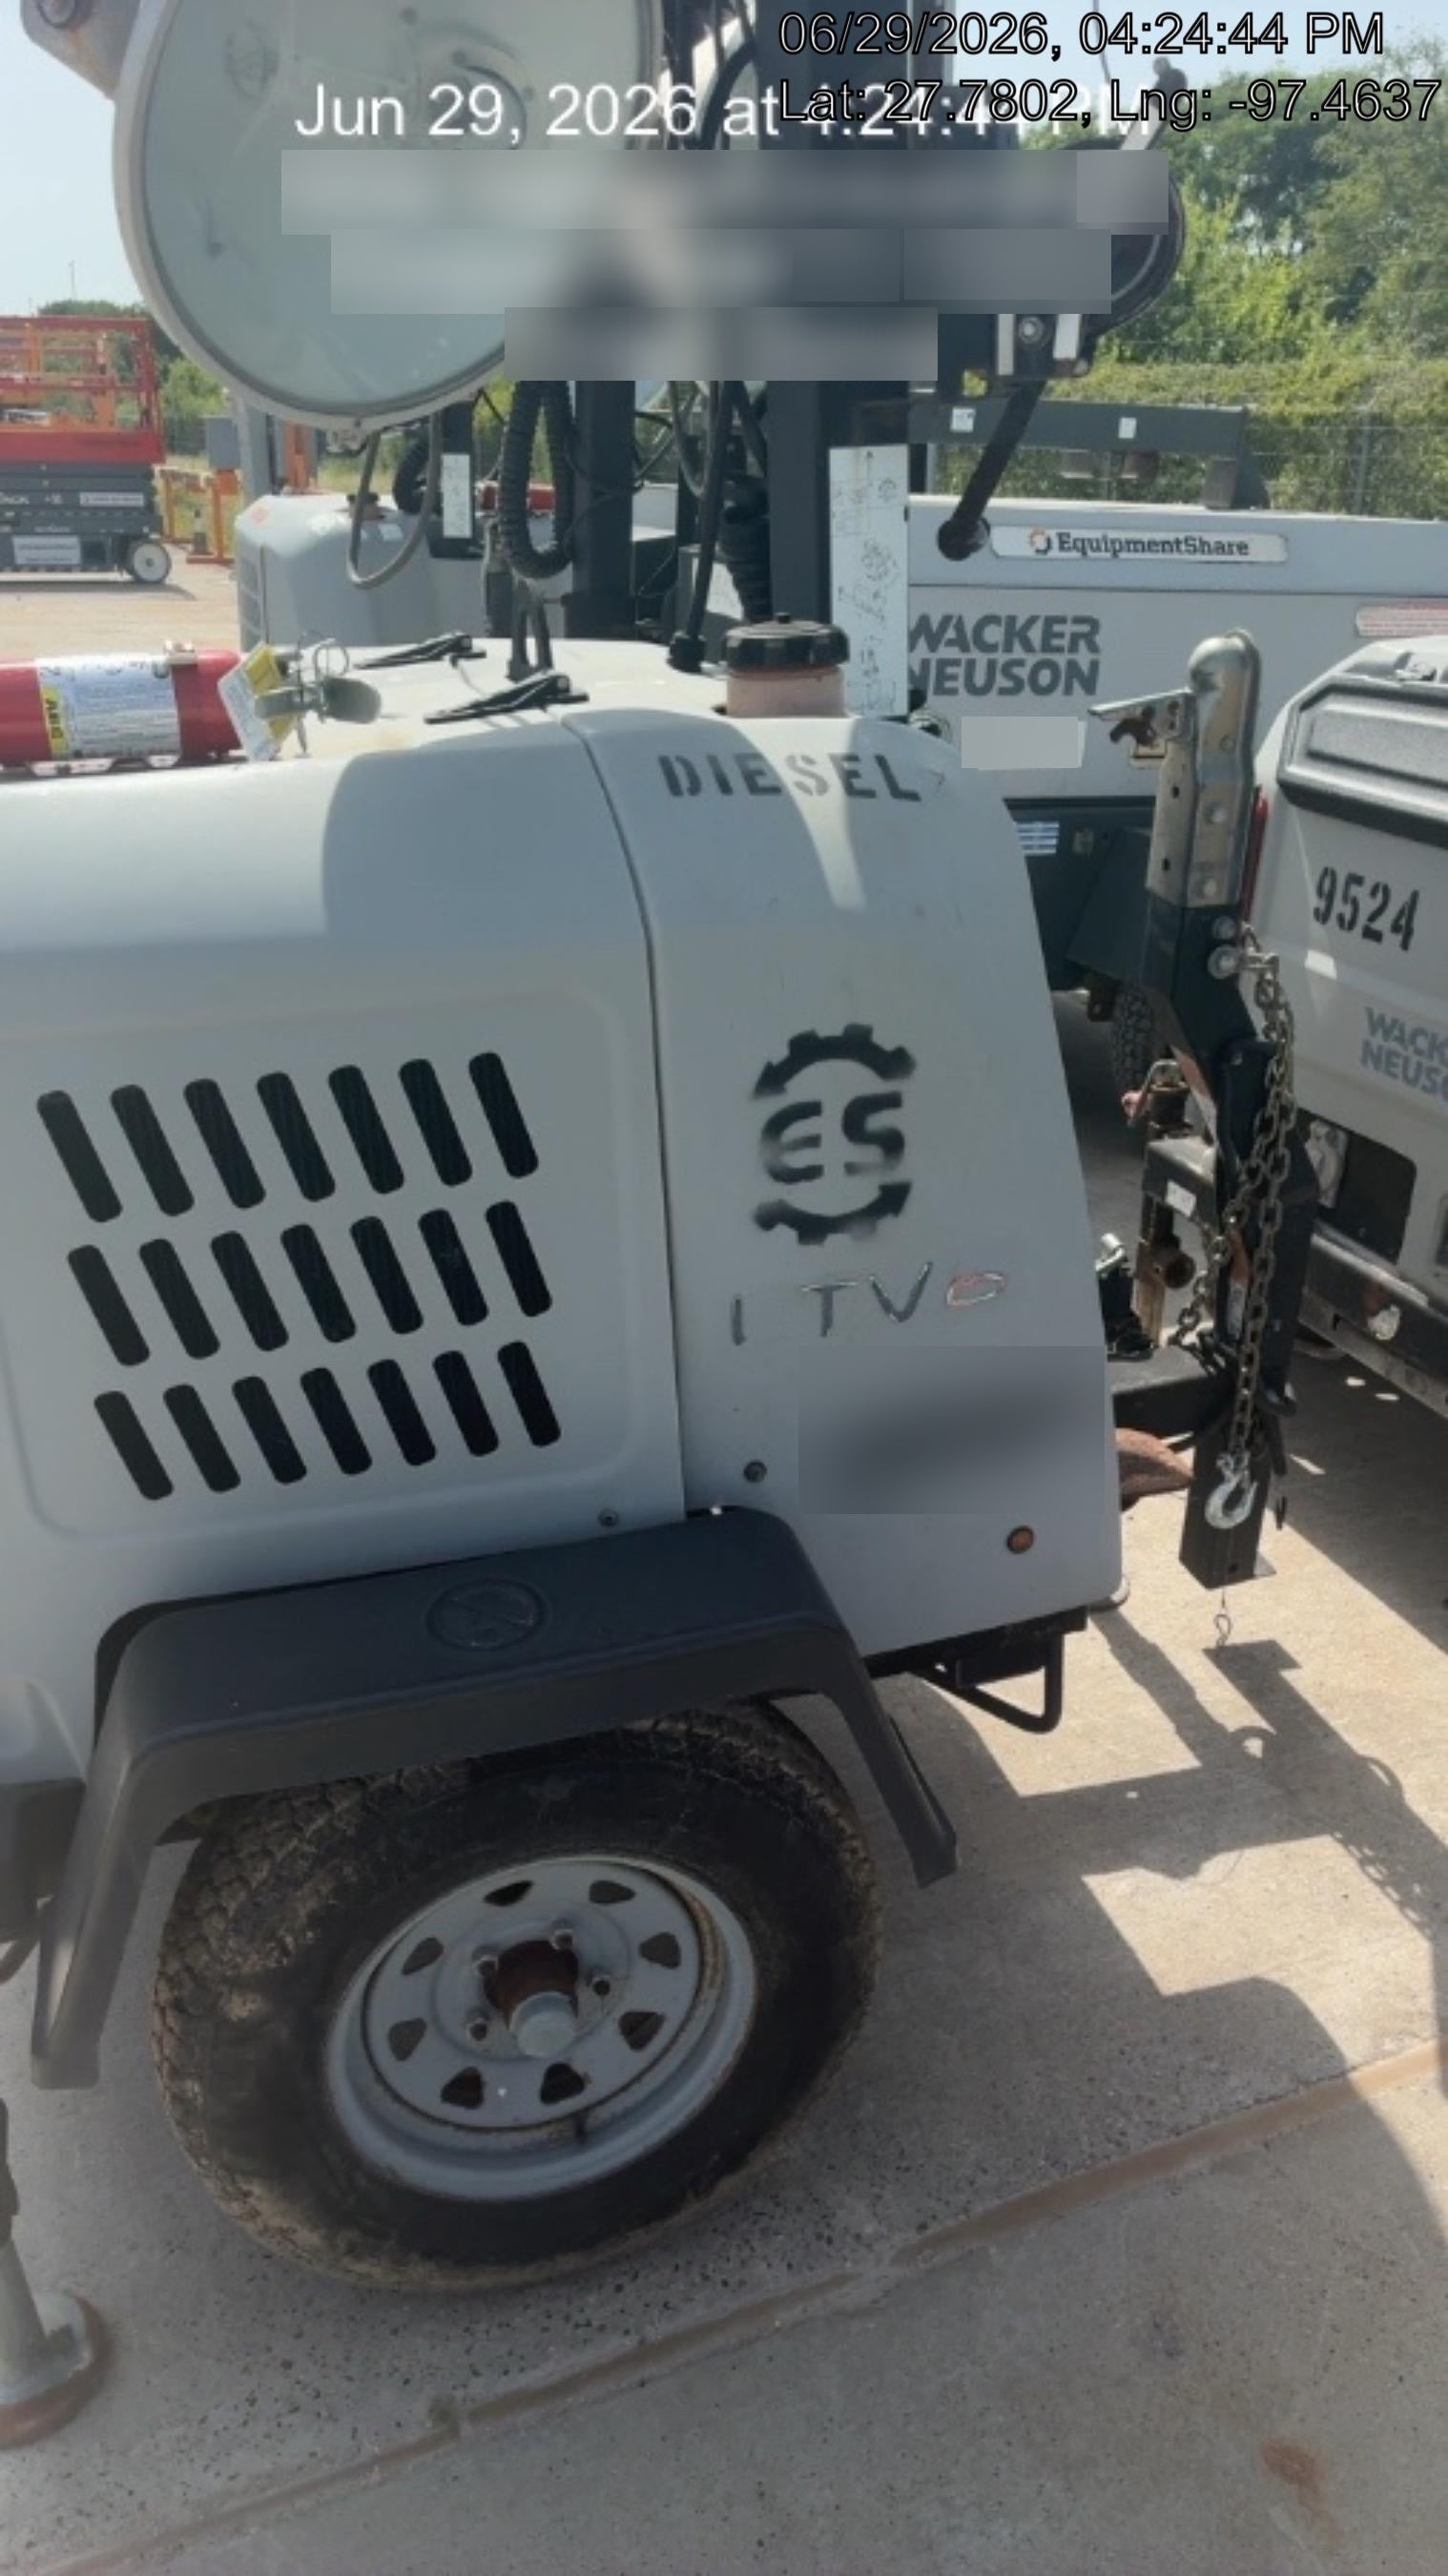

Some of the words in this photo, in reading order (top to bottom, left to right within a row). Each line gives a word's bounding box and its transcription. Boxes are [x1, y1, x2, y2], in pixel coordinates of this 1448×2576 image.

[1056, 531, 1250, 559] EquipmentShare
[908, 613, 1101, 654] WACKER
[658, 752, 922, 802] DIESEL
[1313, 866, 1420, 952] 9524
[1360, 1037, 1448, 1104] NEUS
[760, 1091, 906, 1184] ES
